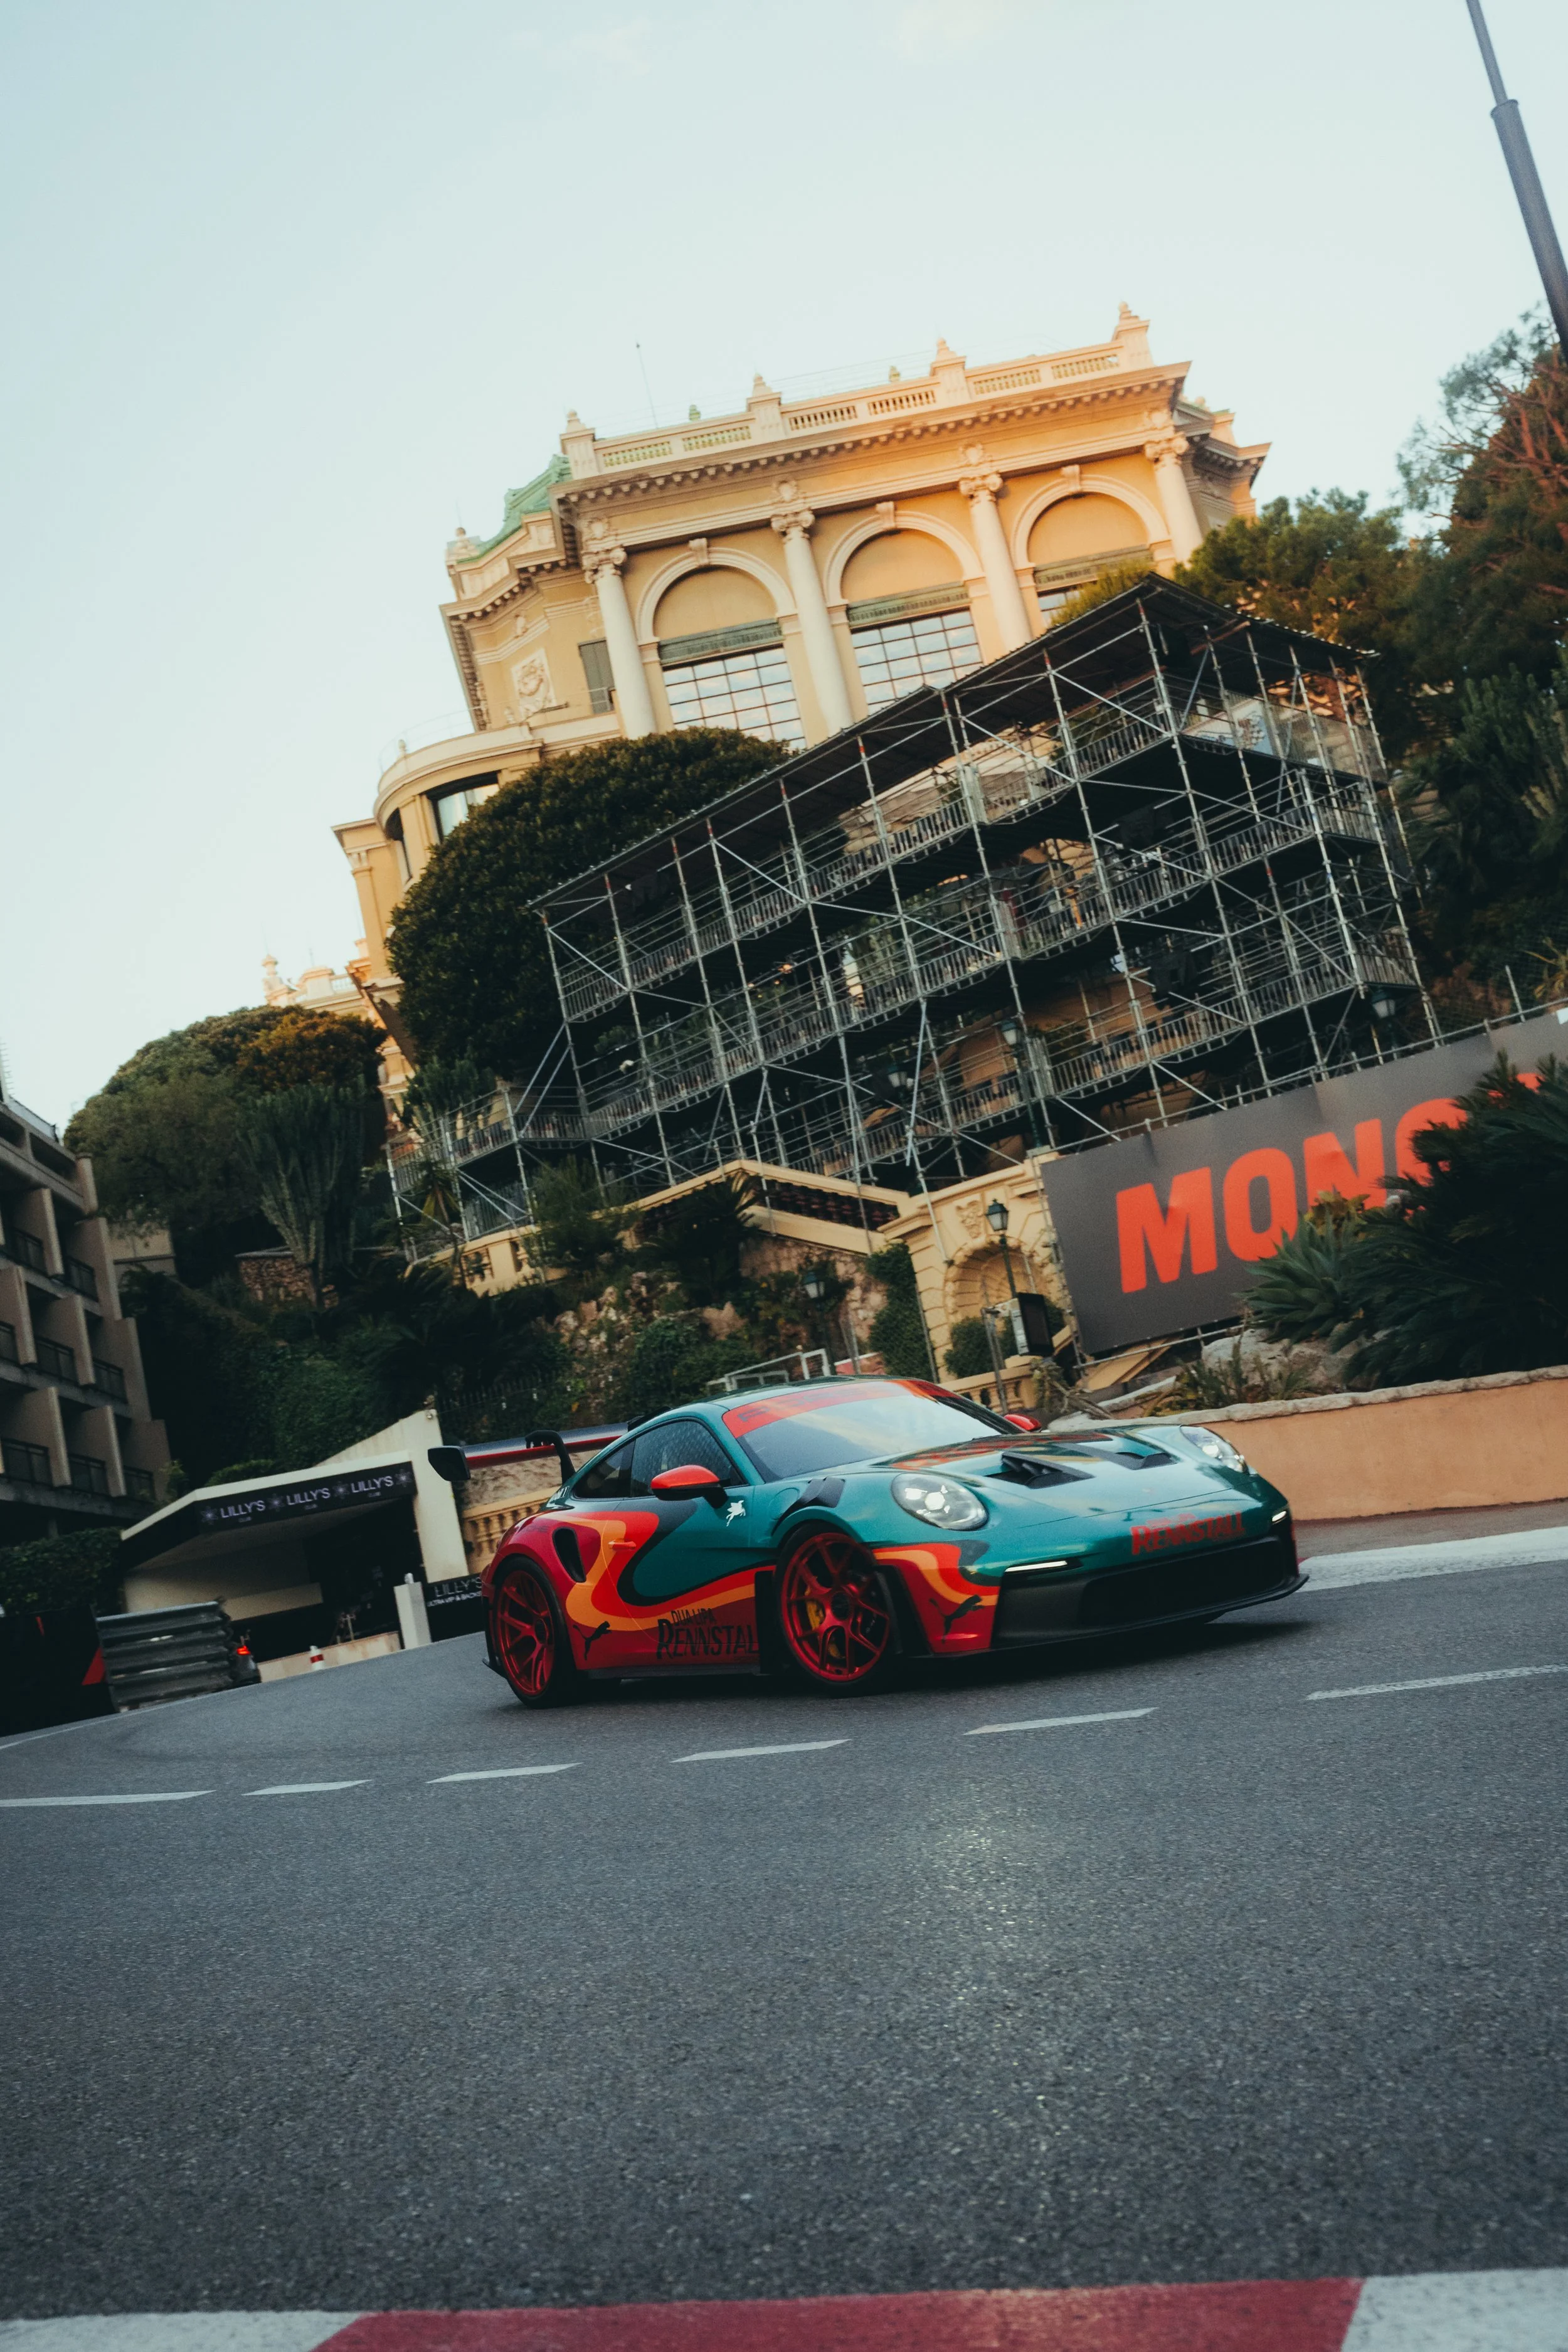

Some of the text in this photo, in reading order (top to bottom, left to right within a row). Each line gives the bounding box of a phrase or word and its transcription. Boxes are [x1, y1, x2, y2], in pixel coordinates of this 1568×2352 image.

[221, 1476, 394, 1518] LILLY'S LILLY'S LILLY'S
[1130, 1511, 1246, 1555] RENNSTALL
[433, 1576, 482, 1598] LILLY'S
[670, 1608, 717, 1626] DUA LIPA
